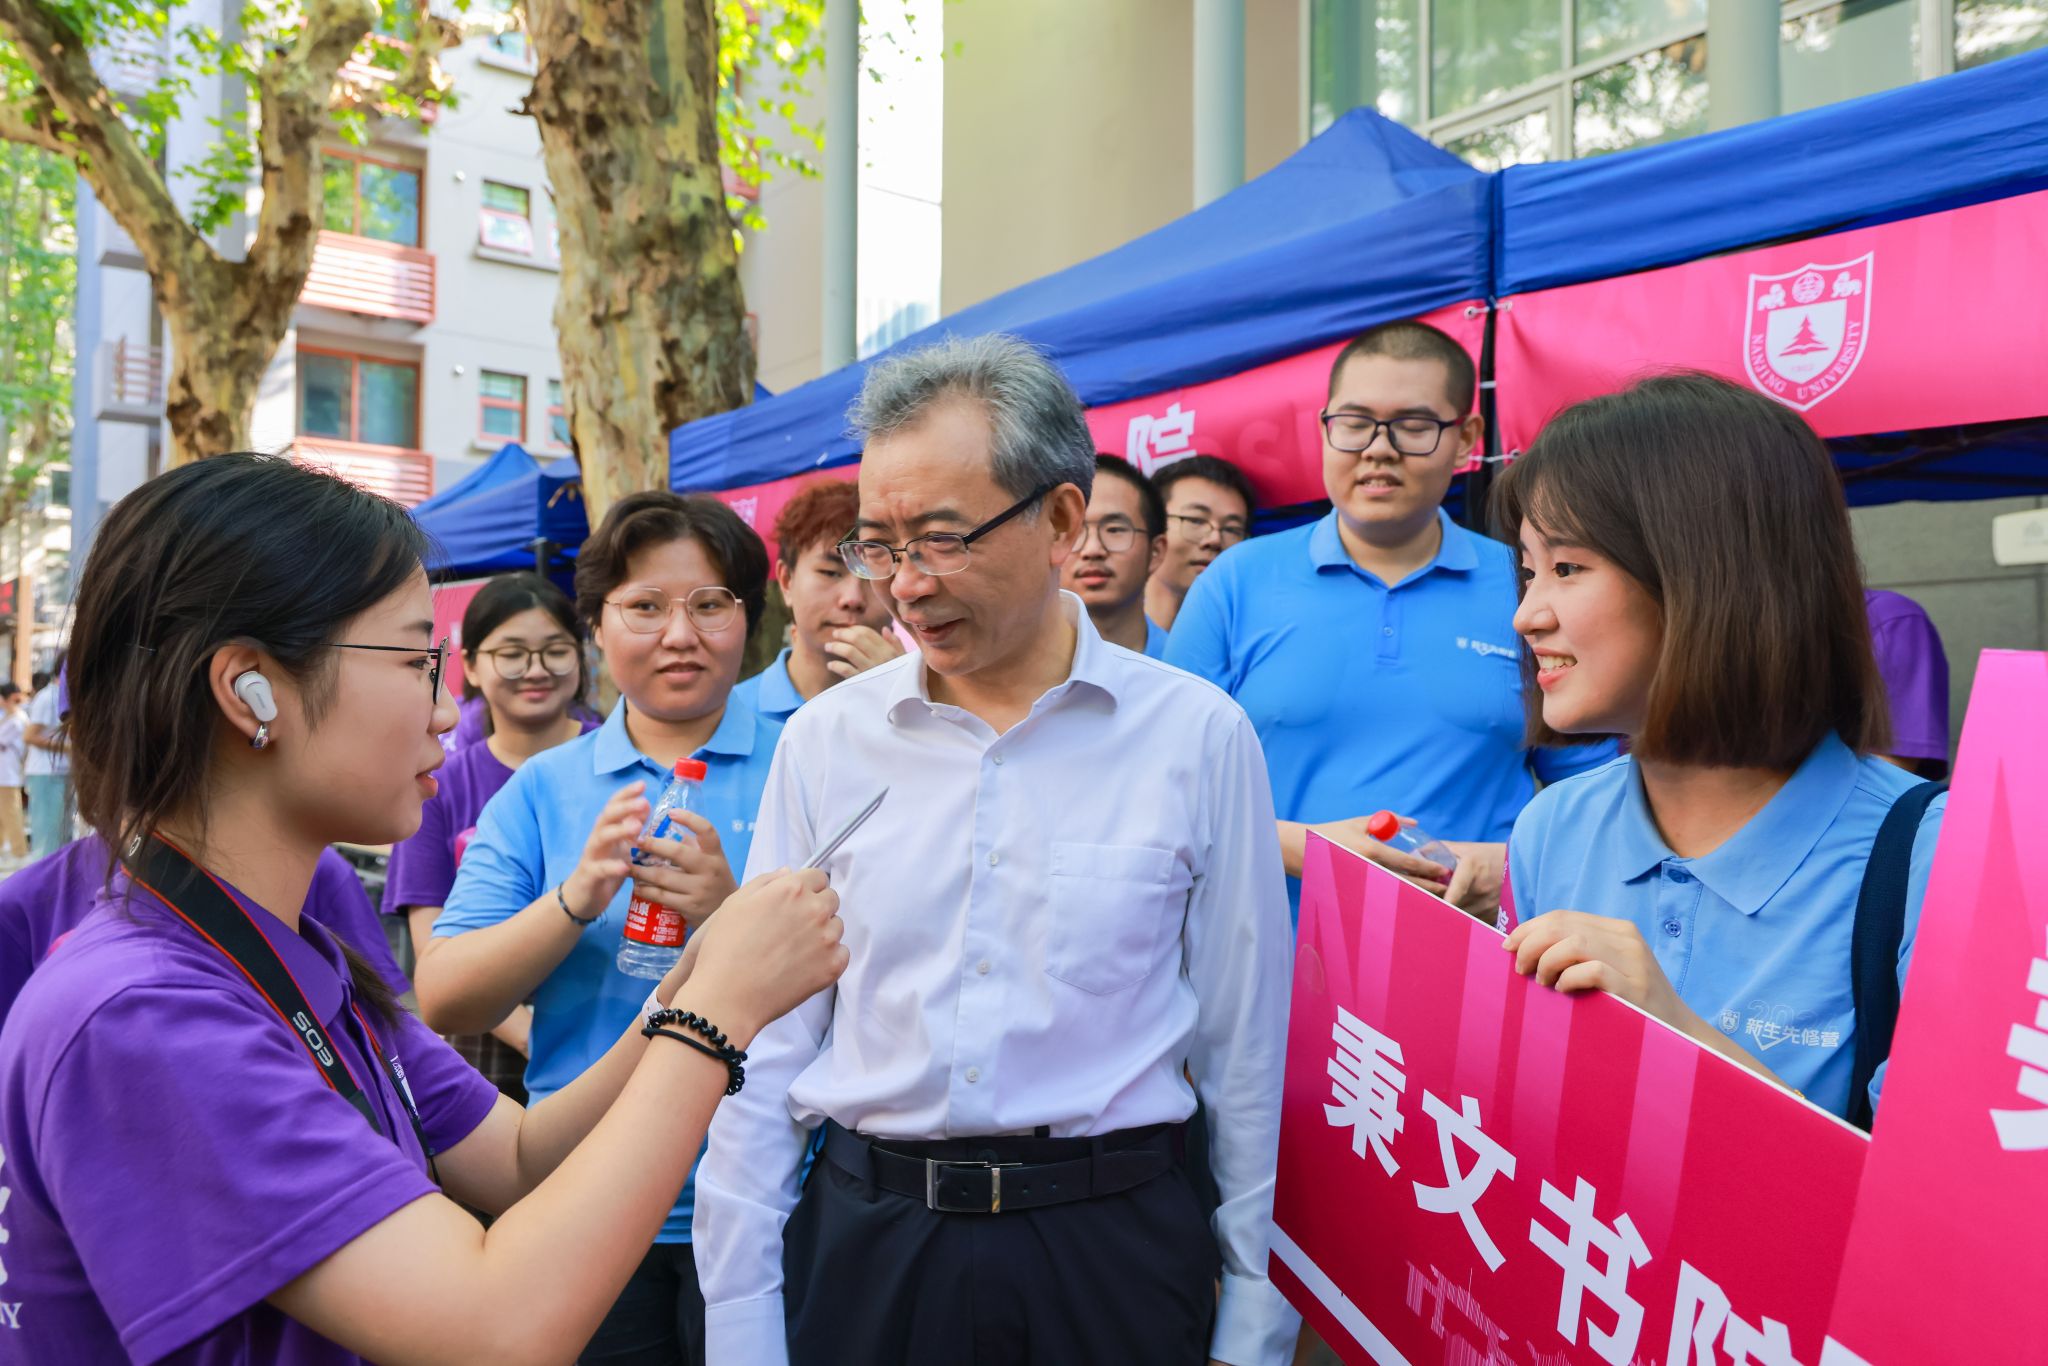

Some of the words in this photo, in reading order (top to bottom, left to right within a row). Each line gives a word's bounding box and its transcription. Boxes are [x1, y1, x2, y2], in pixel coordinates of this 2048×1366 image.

[1751, 332, 1787, 394] NANJING
[1796, 319, 1861, 400] UNIVERSITY
[1126, 402, 1197, 478] 院
[292, 1011, 334, 1067] EOS
[1745, 1017, 1840, 1048] 新生先修营
